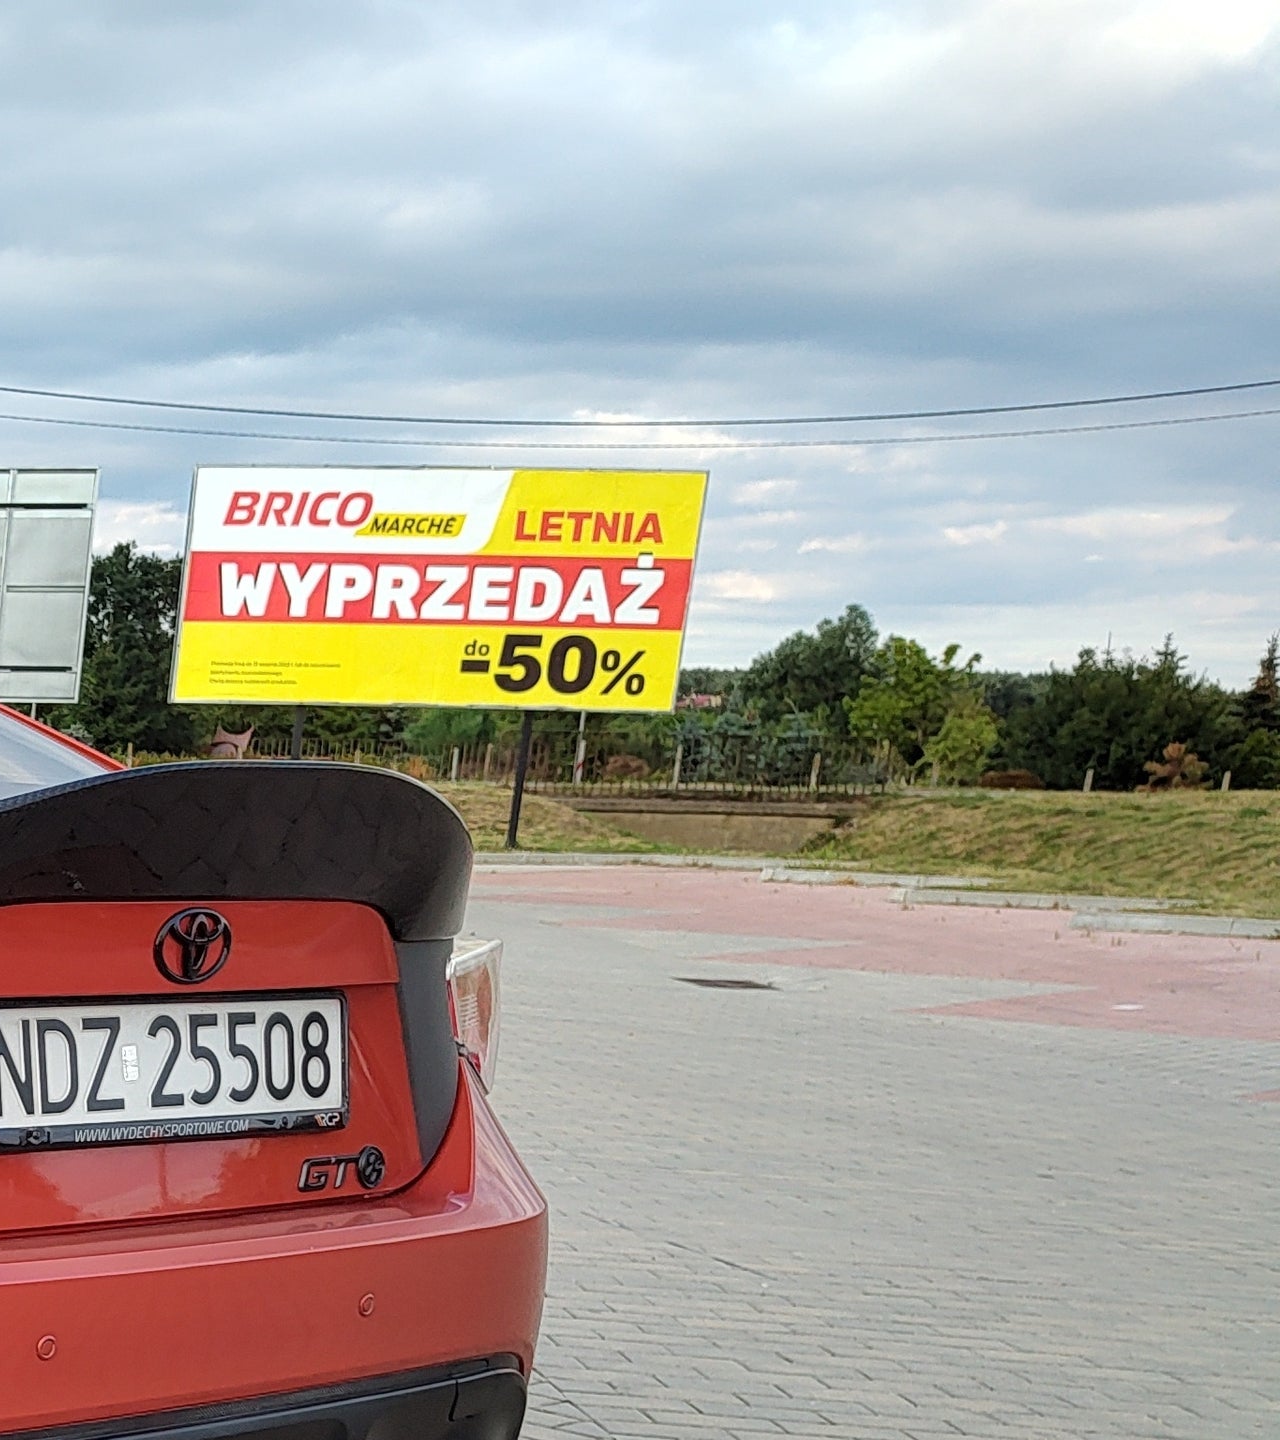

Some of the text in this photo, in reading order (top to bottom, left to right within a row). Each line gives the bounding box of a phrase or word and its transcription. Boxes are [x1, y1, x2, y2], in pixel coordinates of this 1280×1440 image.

[223, 491, 373, 527] BRICO
[514, 510, 664, 544] LETNIA
[219, 552, 665, 625] WYPRZEDAŻ
[464, 639, 490, 656] do
[146, 1010, 330, 1108] 25508
[74, 1119, 249, 1143] WWW.WYDECHYSPORTOWE.COM
